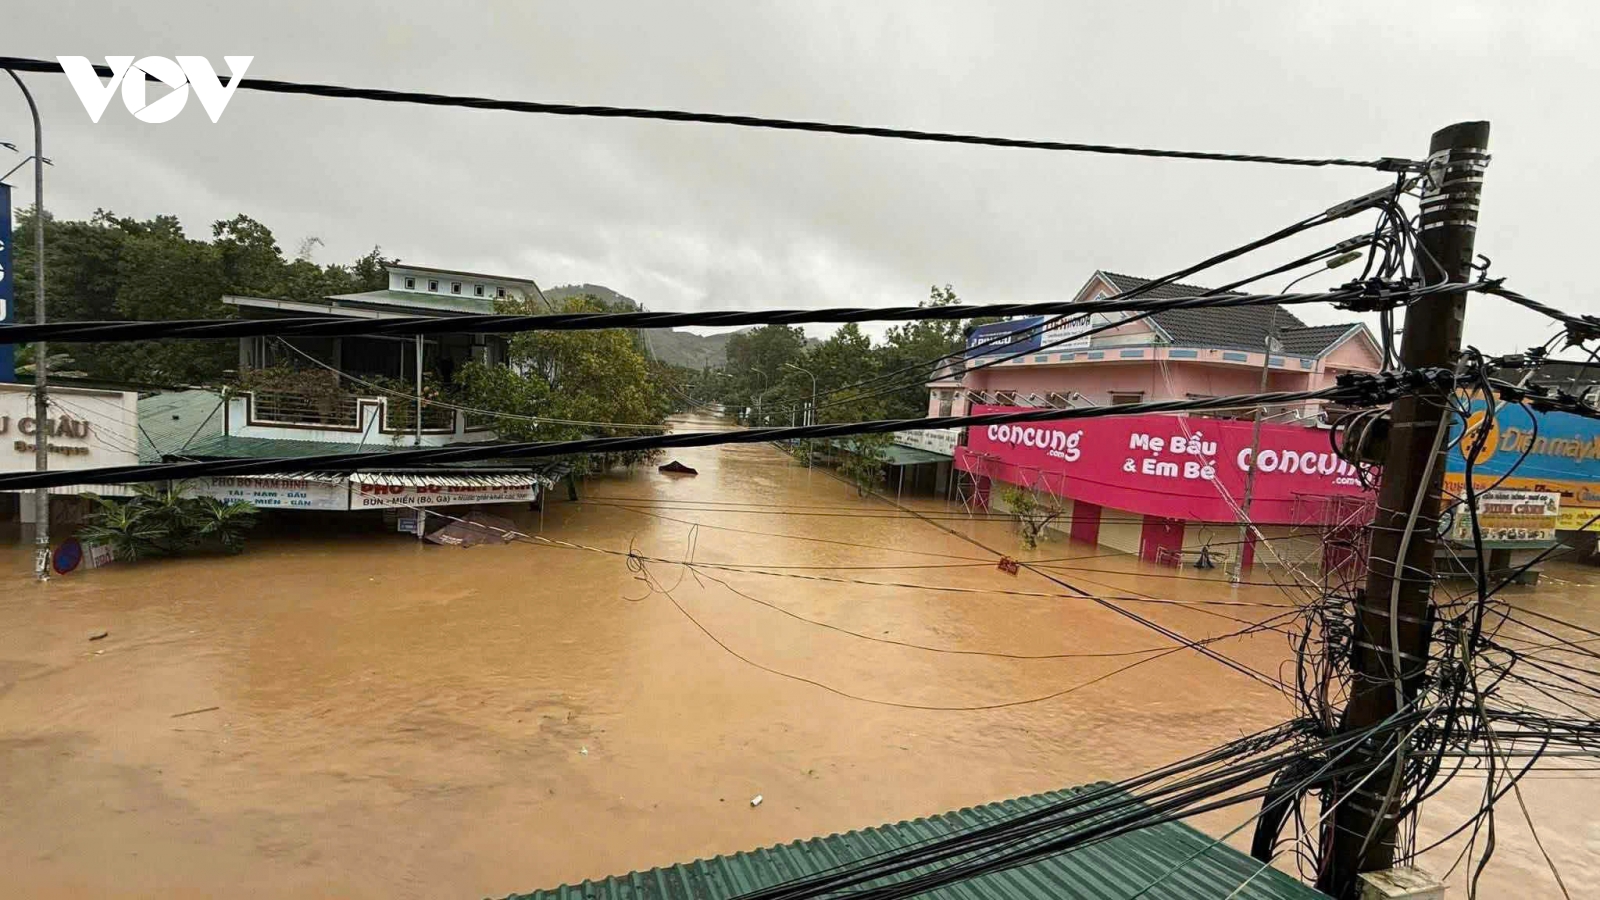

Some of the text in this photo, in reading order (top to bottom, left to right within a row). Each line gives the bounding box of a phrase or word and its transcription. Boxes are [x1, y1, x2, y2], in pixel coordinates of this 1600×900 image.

[14, 441, 89, 456] Botique
[1130, 431, 1217, 457] Mẹ Bầu
[1123, 459, 1216, 480] & Em Bé
